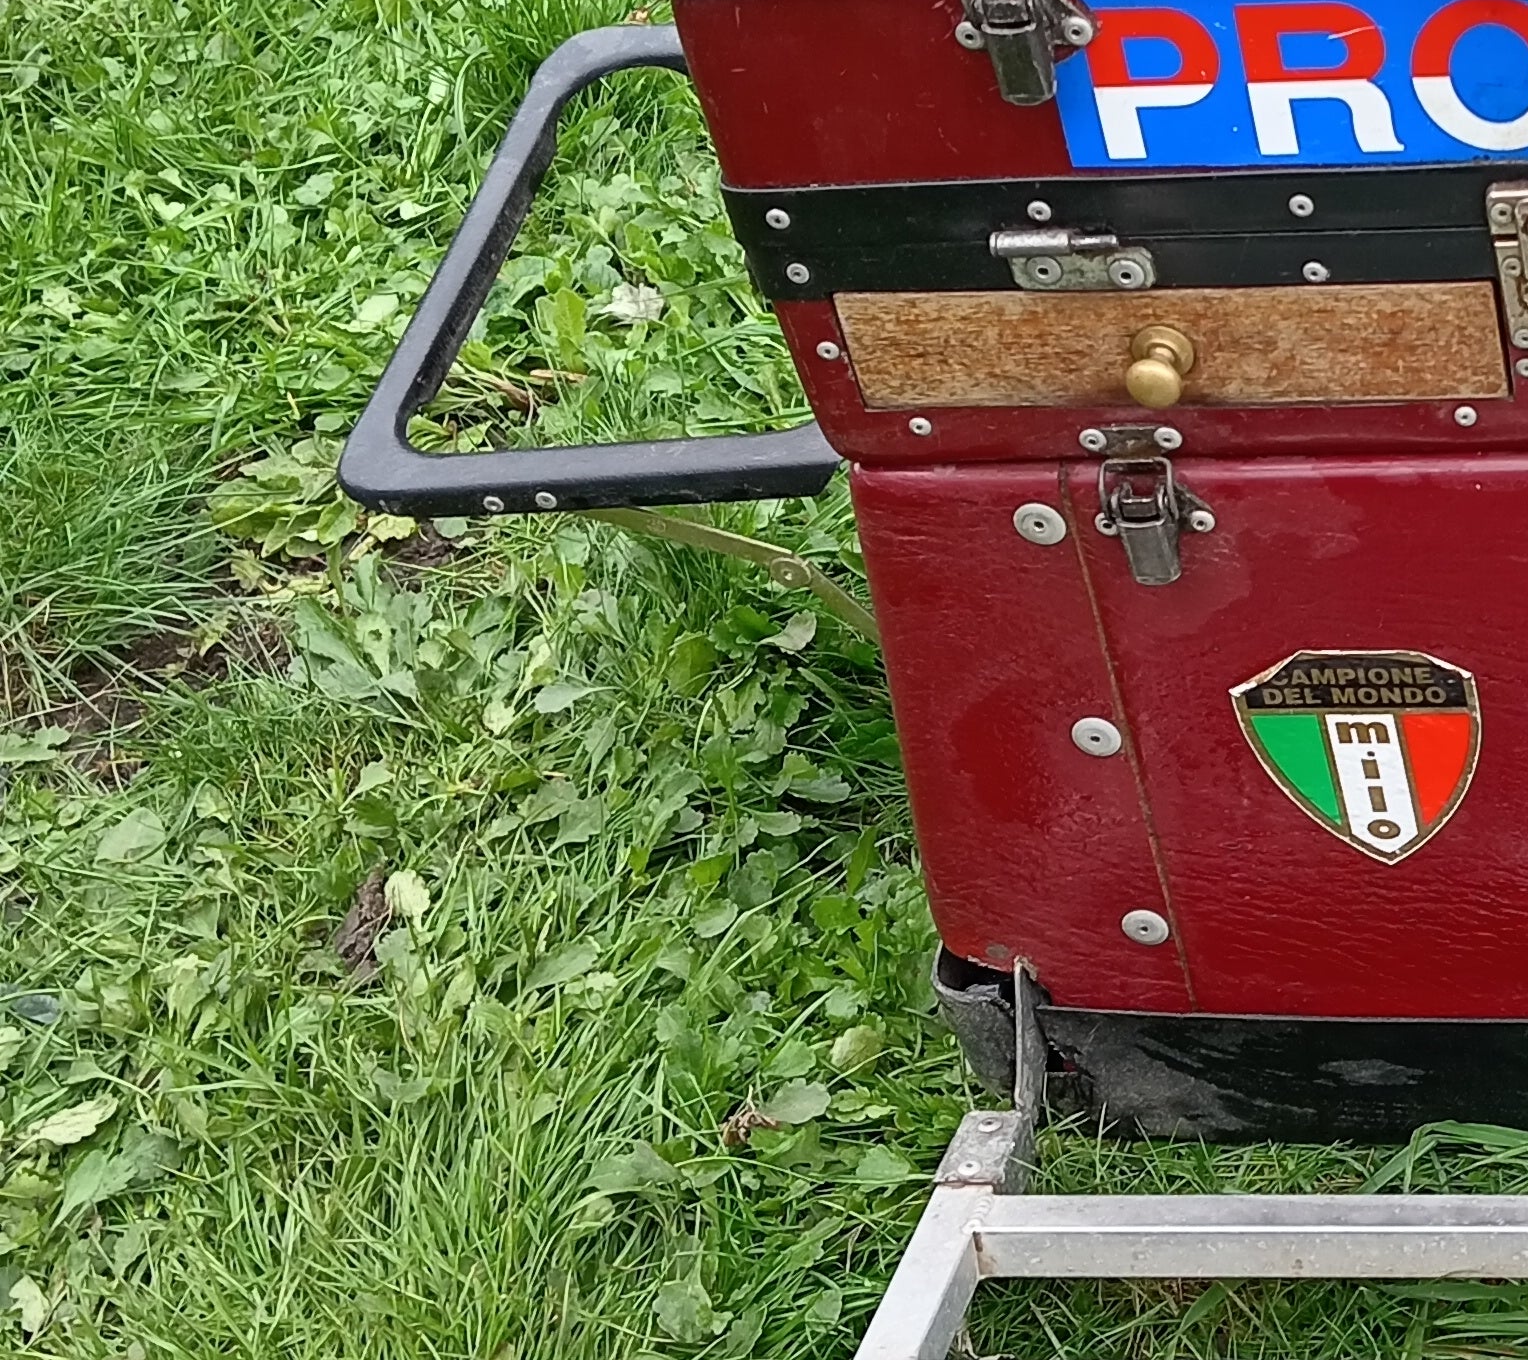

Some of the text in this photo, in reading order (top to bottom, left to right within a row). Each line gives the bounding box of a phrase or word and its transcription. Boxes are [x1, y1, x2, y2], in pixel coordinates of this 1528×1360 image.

[1262, 687, 1447, 705] DEL MONDO
[1334, 721, 1402, 840] milo
